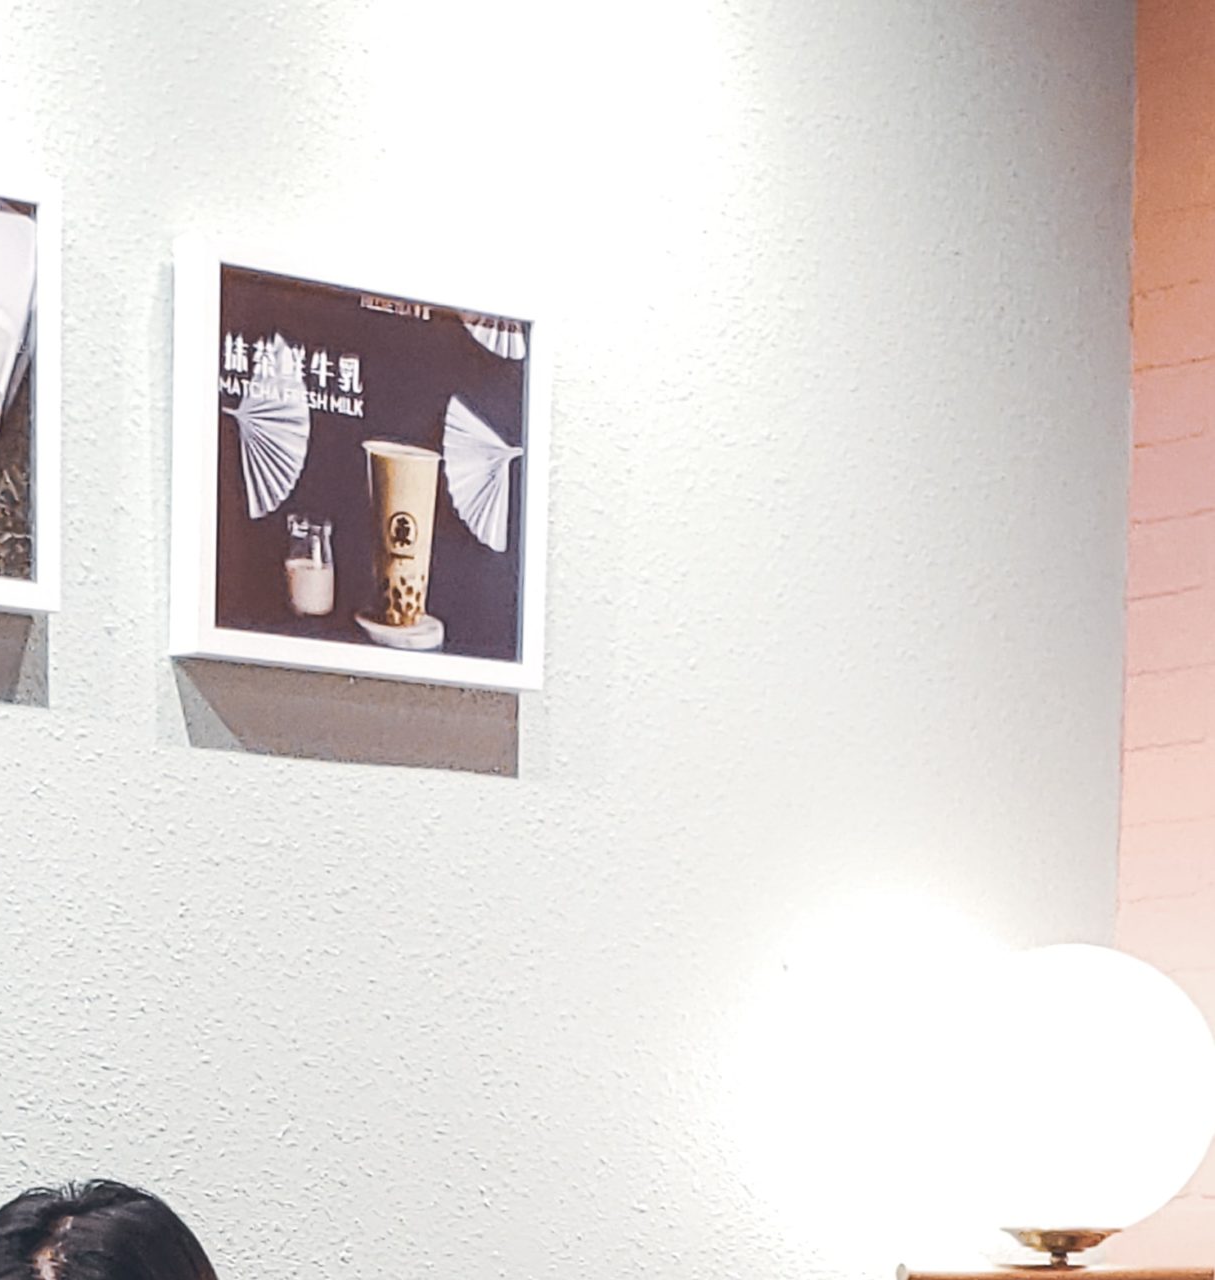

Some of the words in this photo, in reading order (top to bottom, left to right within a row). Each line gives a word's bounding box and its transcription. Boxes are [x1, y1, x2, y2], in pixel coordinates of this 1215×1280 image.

[219, 376, 280, 399] MATCHA
[283, 388, 327, 410] FRESH
[330, 395, 364, 418] MILK
